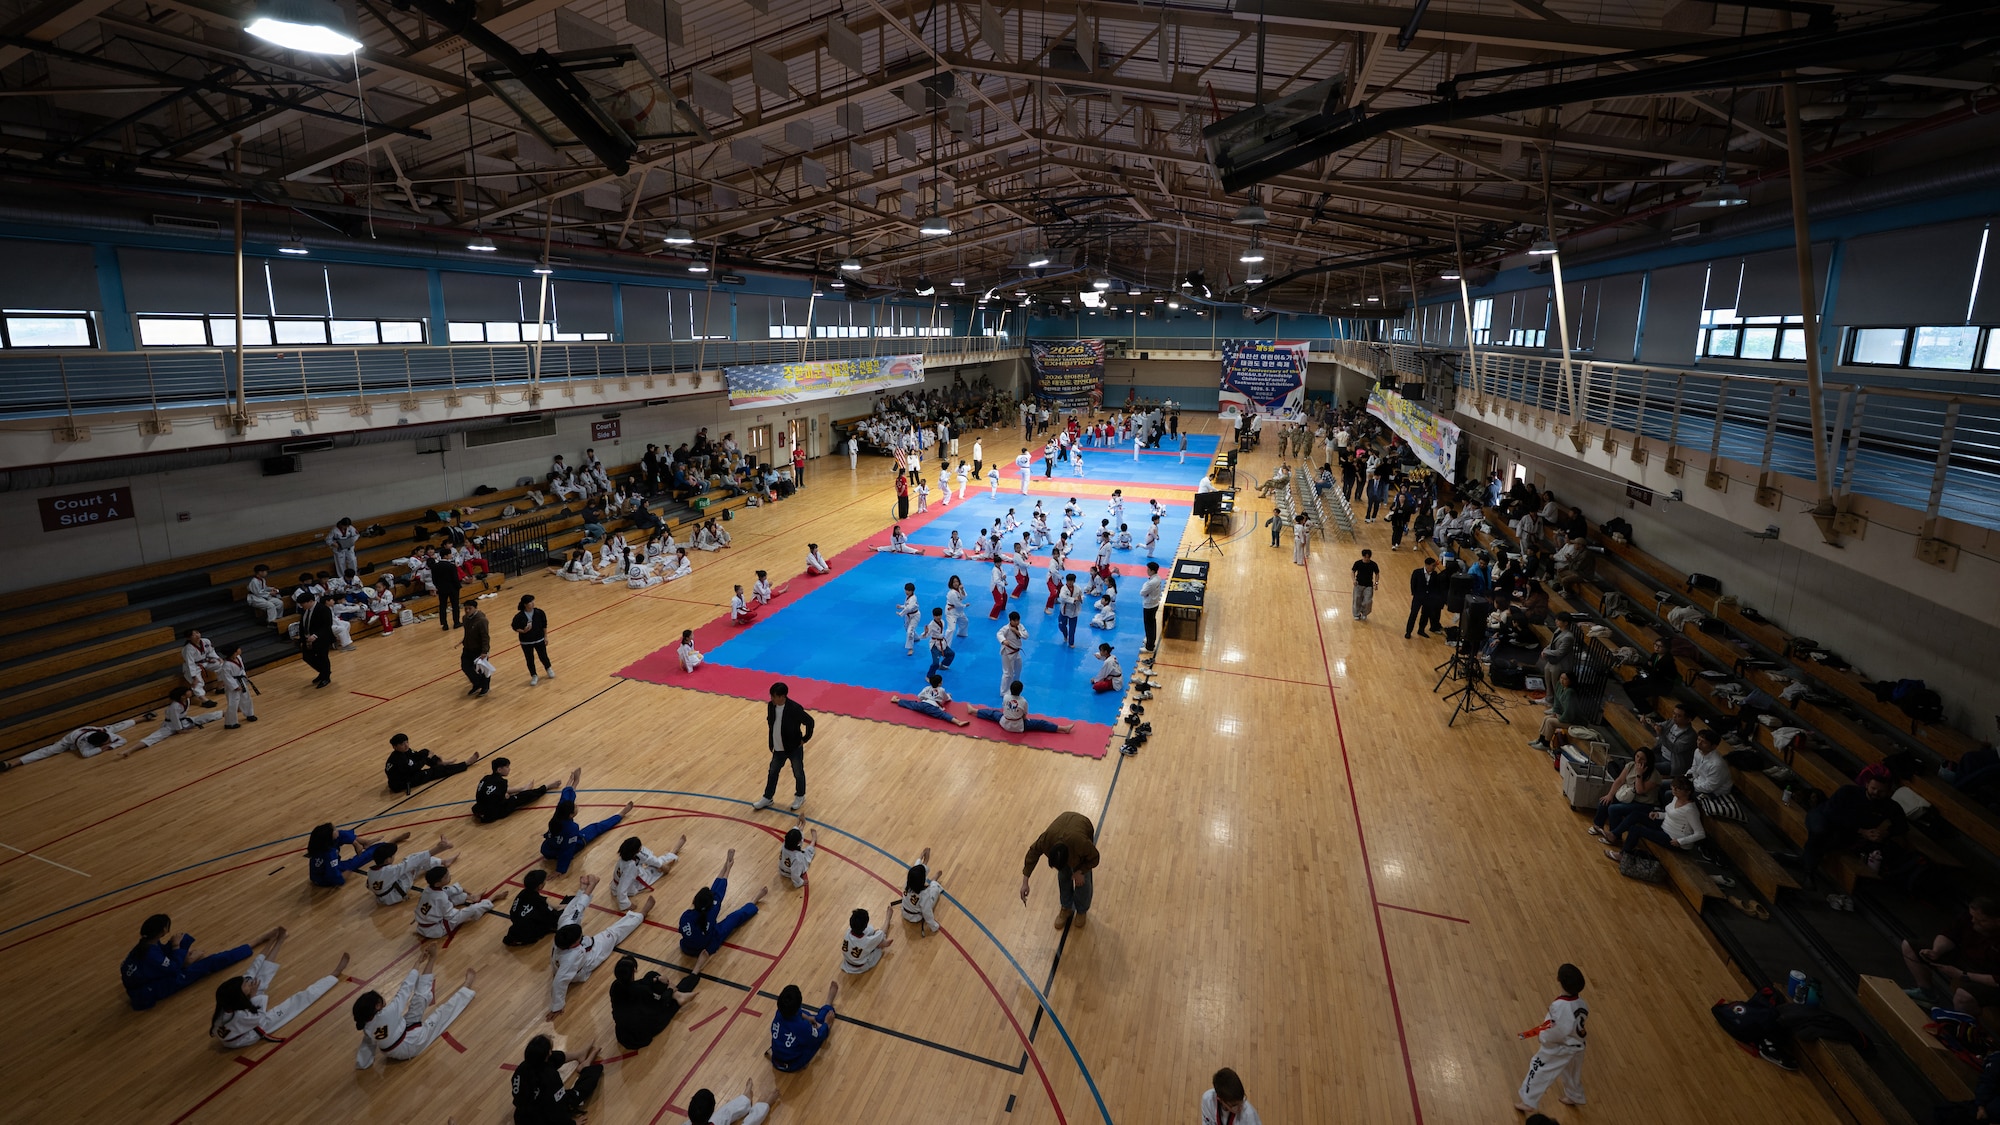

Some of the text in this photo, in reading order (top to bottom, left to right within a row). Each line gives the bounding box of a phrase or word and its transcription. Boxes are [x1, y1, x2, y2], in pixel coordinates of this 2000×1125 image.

[1049, 346, 1084, 354] 2026
[784, 364, 822, 382] 주한미군
[54, 492, 118, 510] Court 1
[60, 508, 118, 525] Side A
